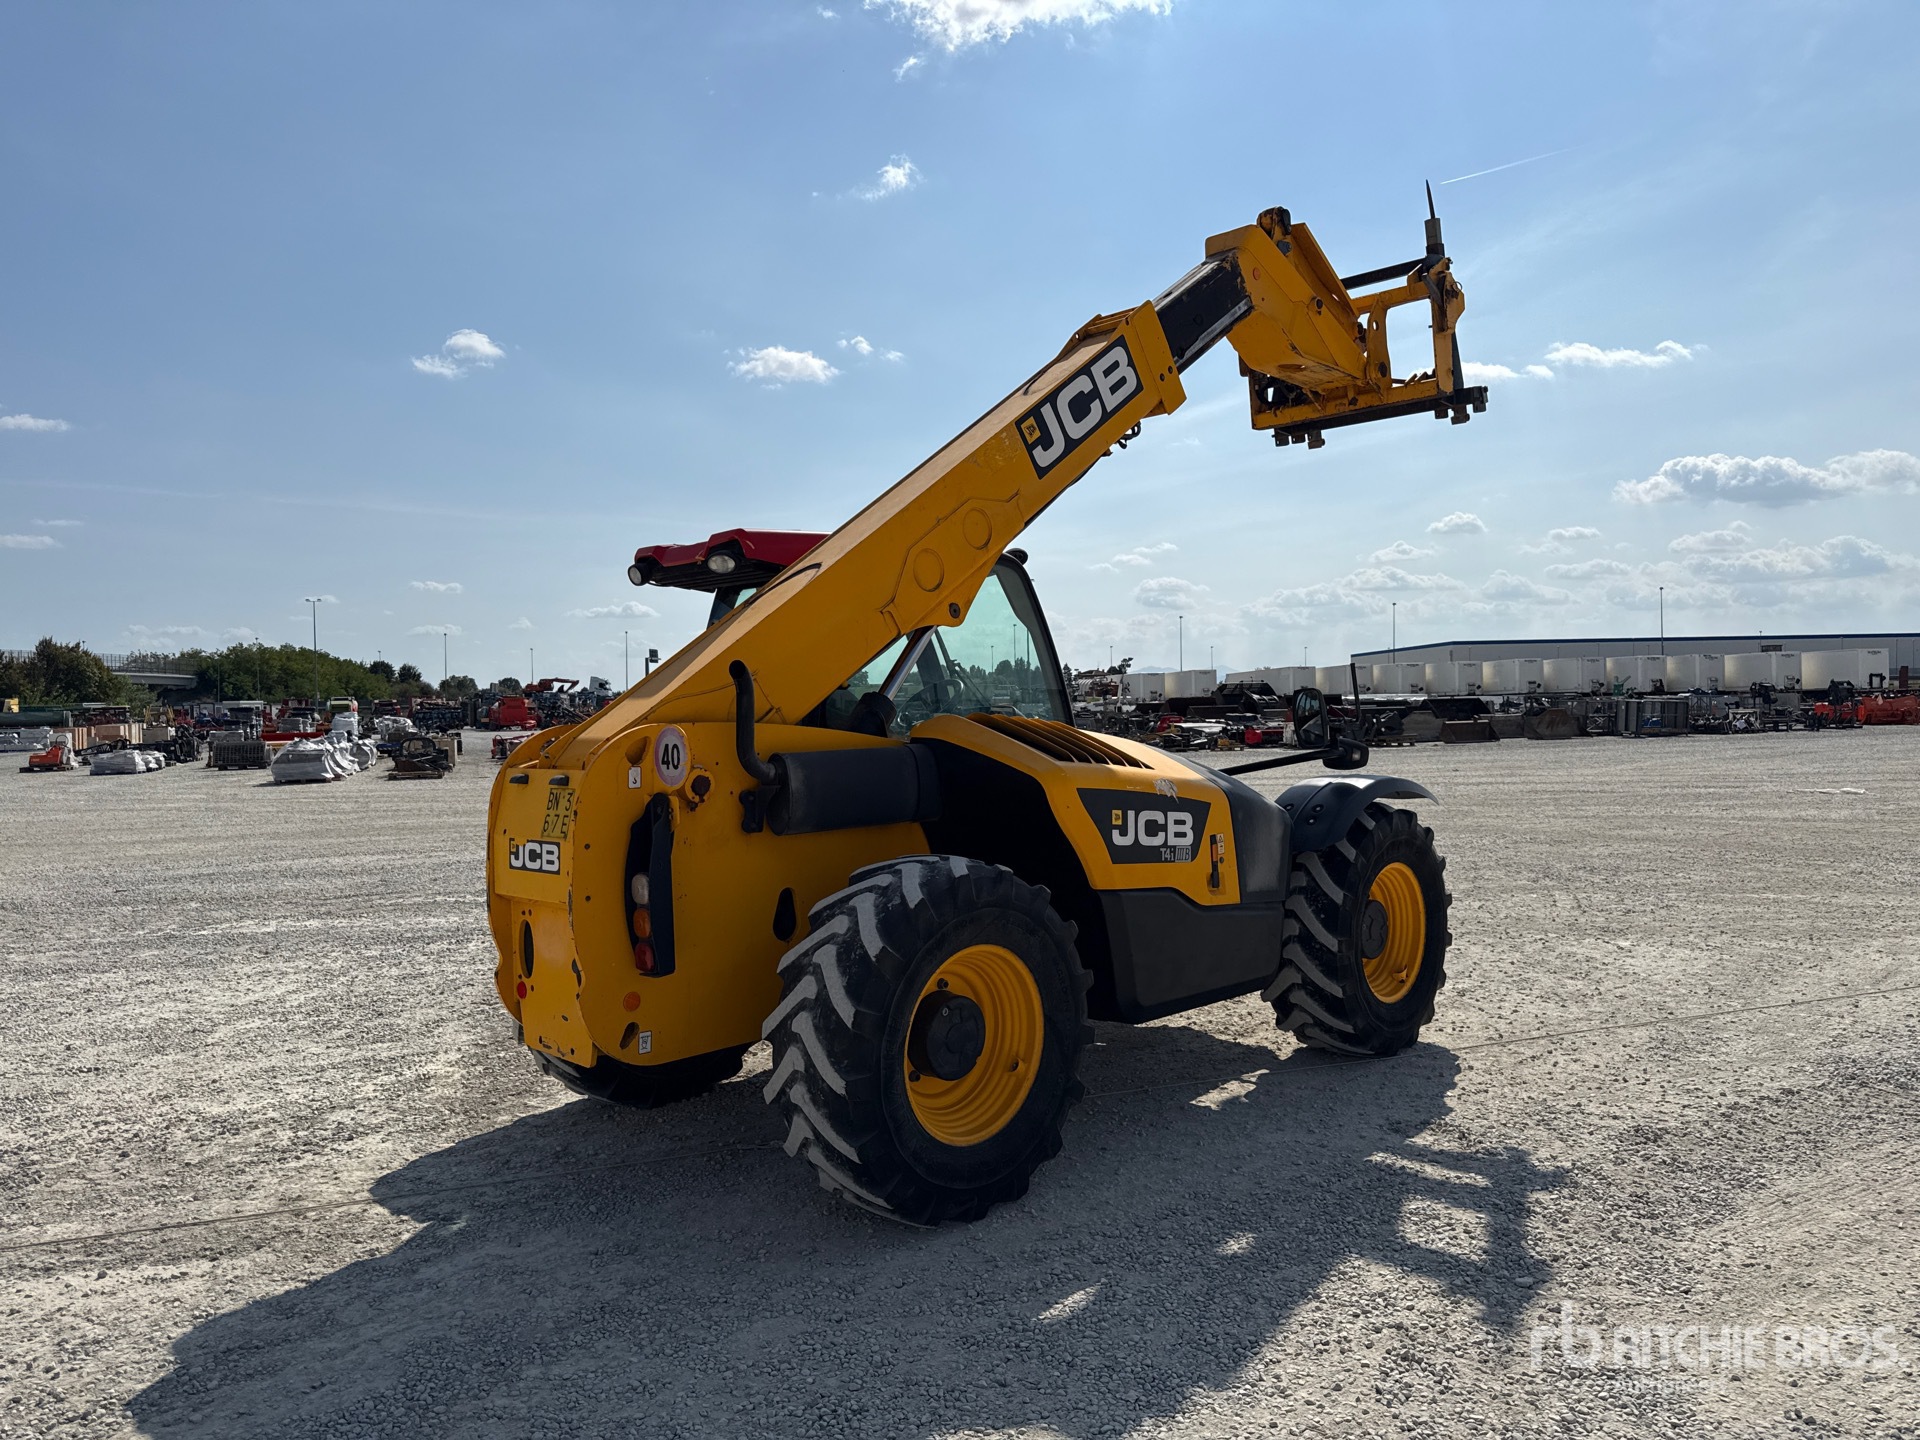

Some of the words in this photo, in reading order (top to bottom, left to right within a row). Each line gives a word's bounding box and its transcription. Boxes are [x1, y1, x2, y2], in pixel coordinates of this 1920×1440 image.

[1032, 346, 1138, 468] JCB
[661, 743, 681, 770] 40
[547, 791, 561, 811] BN
[565, 792, 574, 812] 3
[1112, 810, 1194, 846] JCB
[510, 841, 560, 872] JCB
